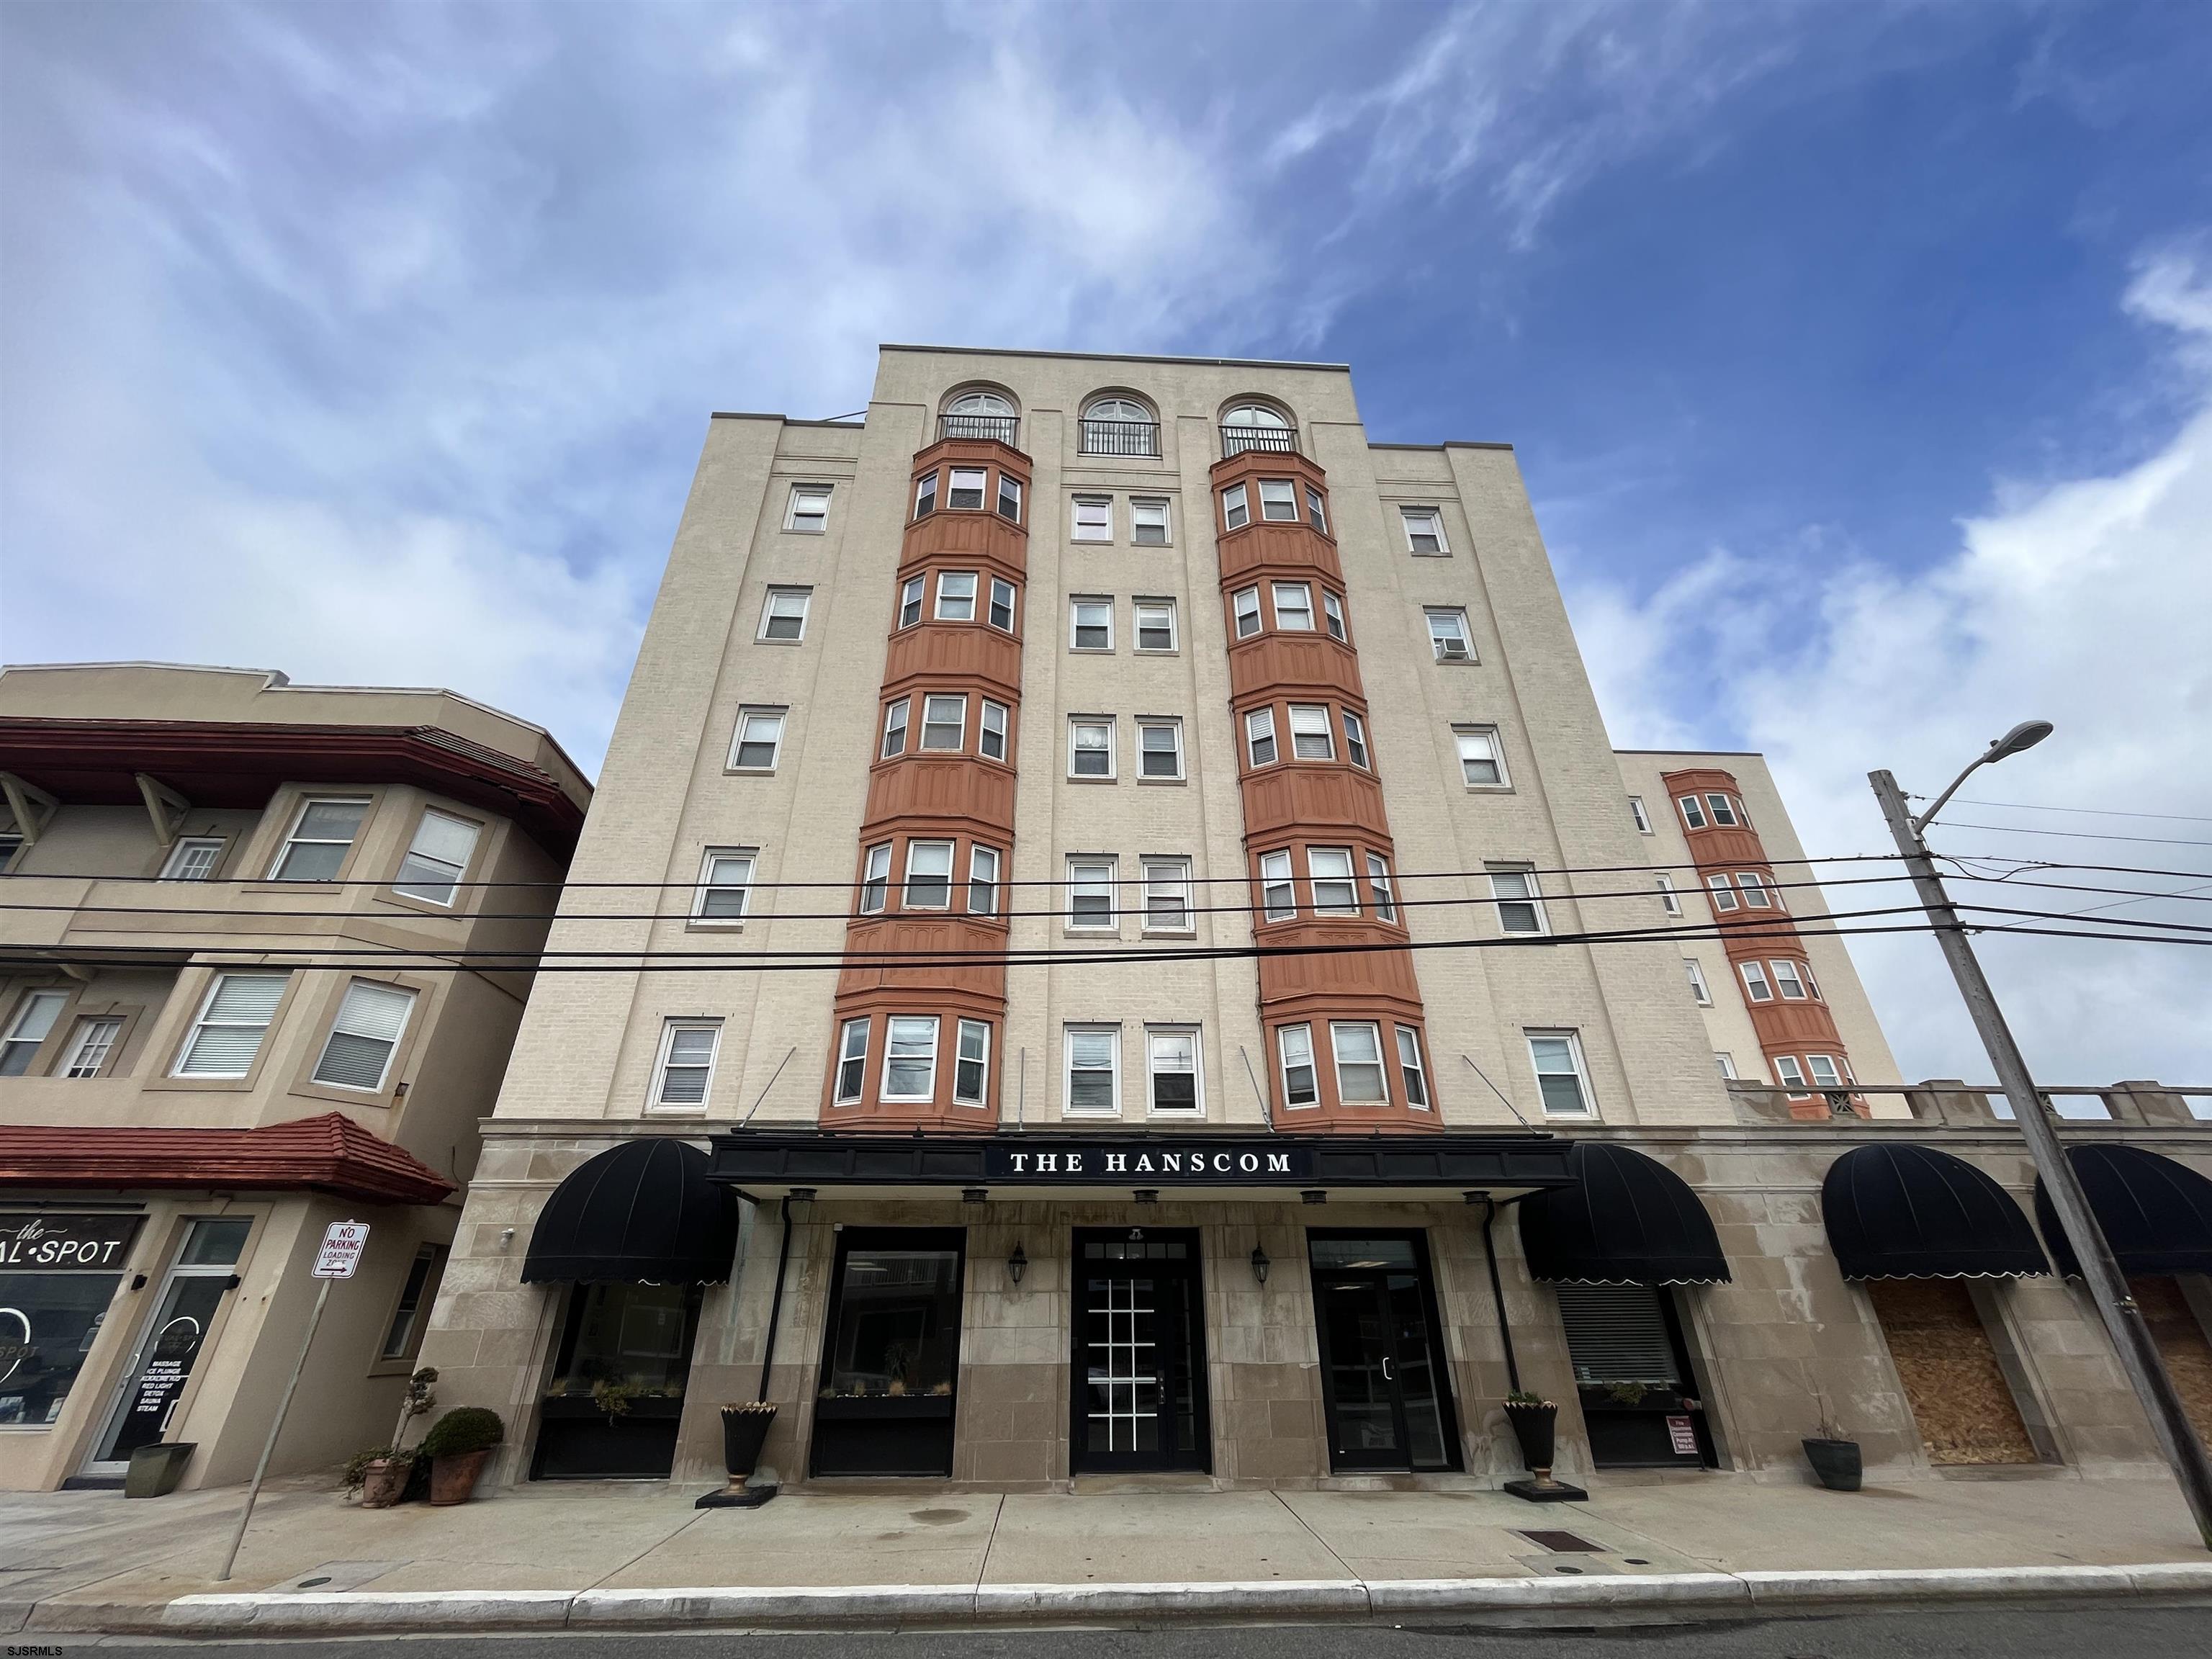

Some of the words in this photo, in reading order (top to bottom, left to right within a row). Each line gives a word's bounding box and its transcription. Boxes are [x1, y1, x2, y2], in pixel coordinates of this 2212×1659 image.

[1010, 1154, 1083, 1172] THE
[1105, 1153, 1291, 1172] HANSCOM
[16, 1219, 45, 1240] the
[338, 1228, 355, 1238] NO
[325, 1239, 361, 1250] PARKING
